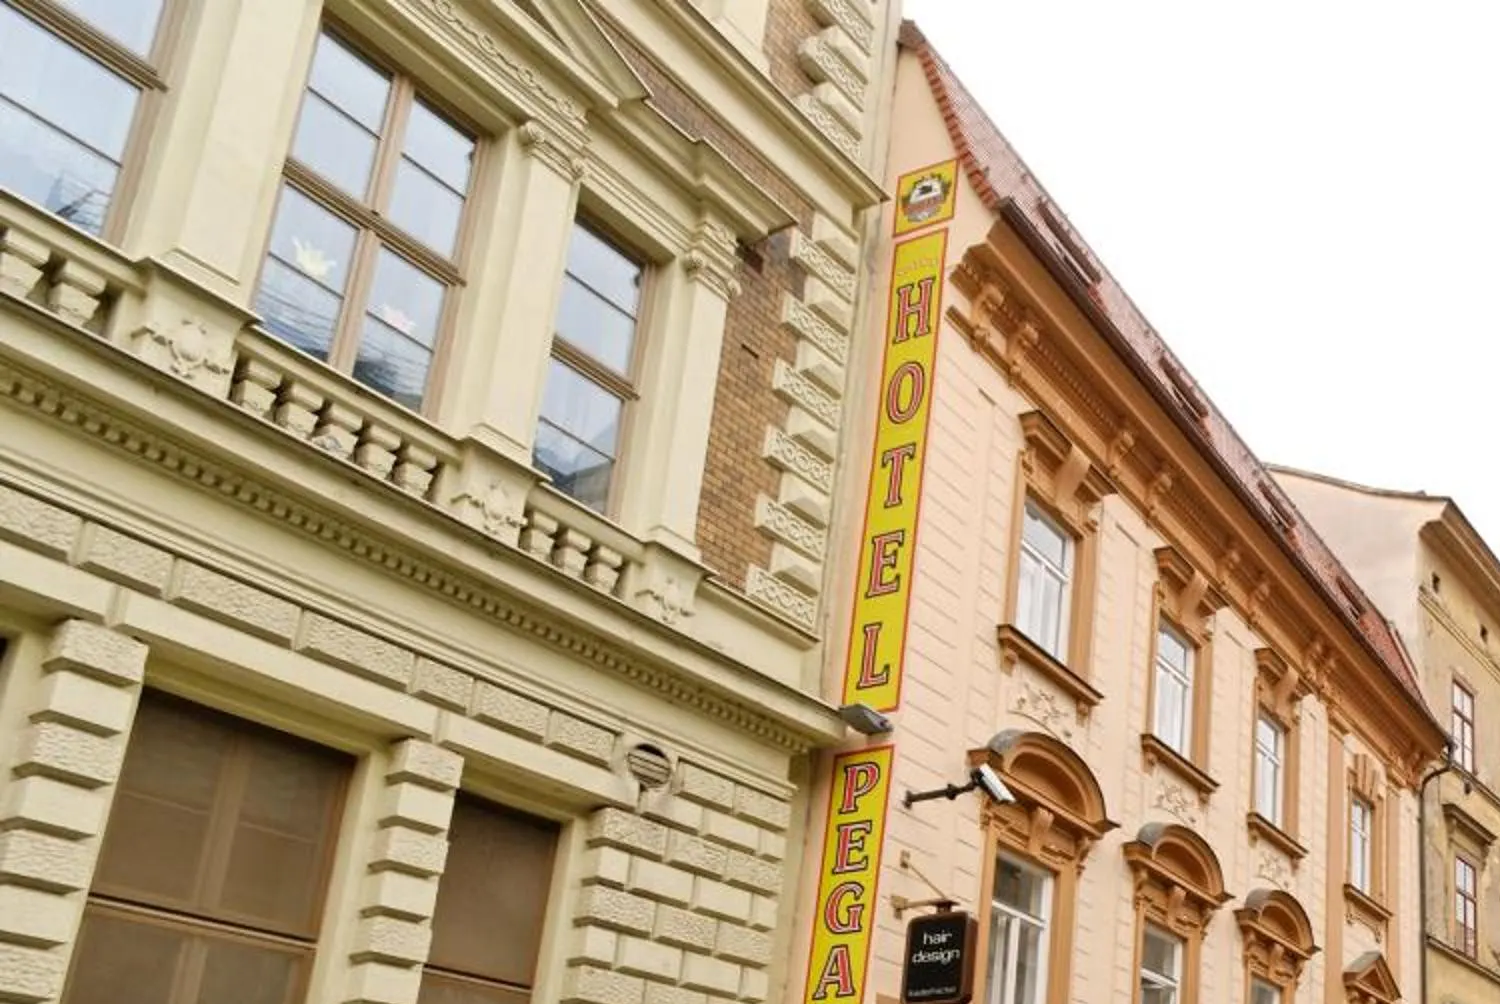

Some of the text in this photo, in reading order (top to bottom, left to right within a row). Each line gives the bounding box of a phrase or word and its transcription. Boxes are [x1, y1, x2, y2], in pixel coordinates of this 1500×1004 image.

[856, 274, 938, 691] HOTEL
[923, 931, 953, 945] hair
[912, 947, 961, 965] design
